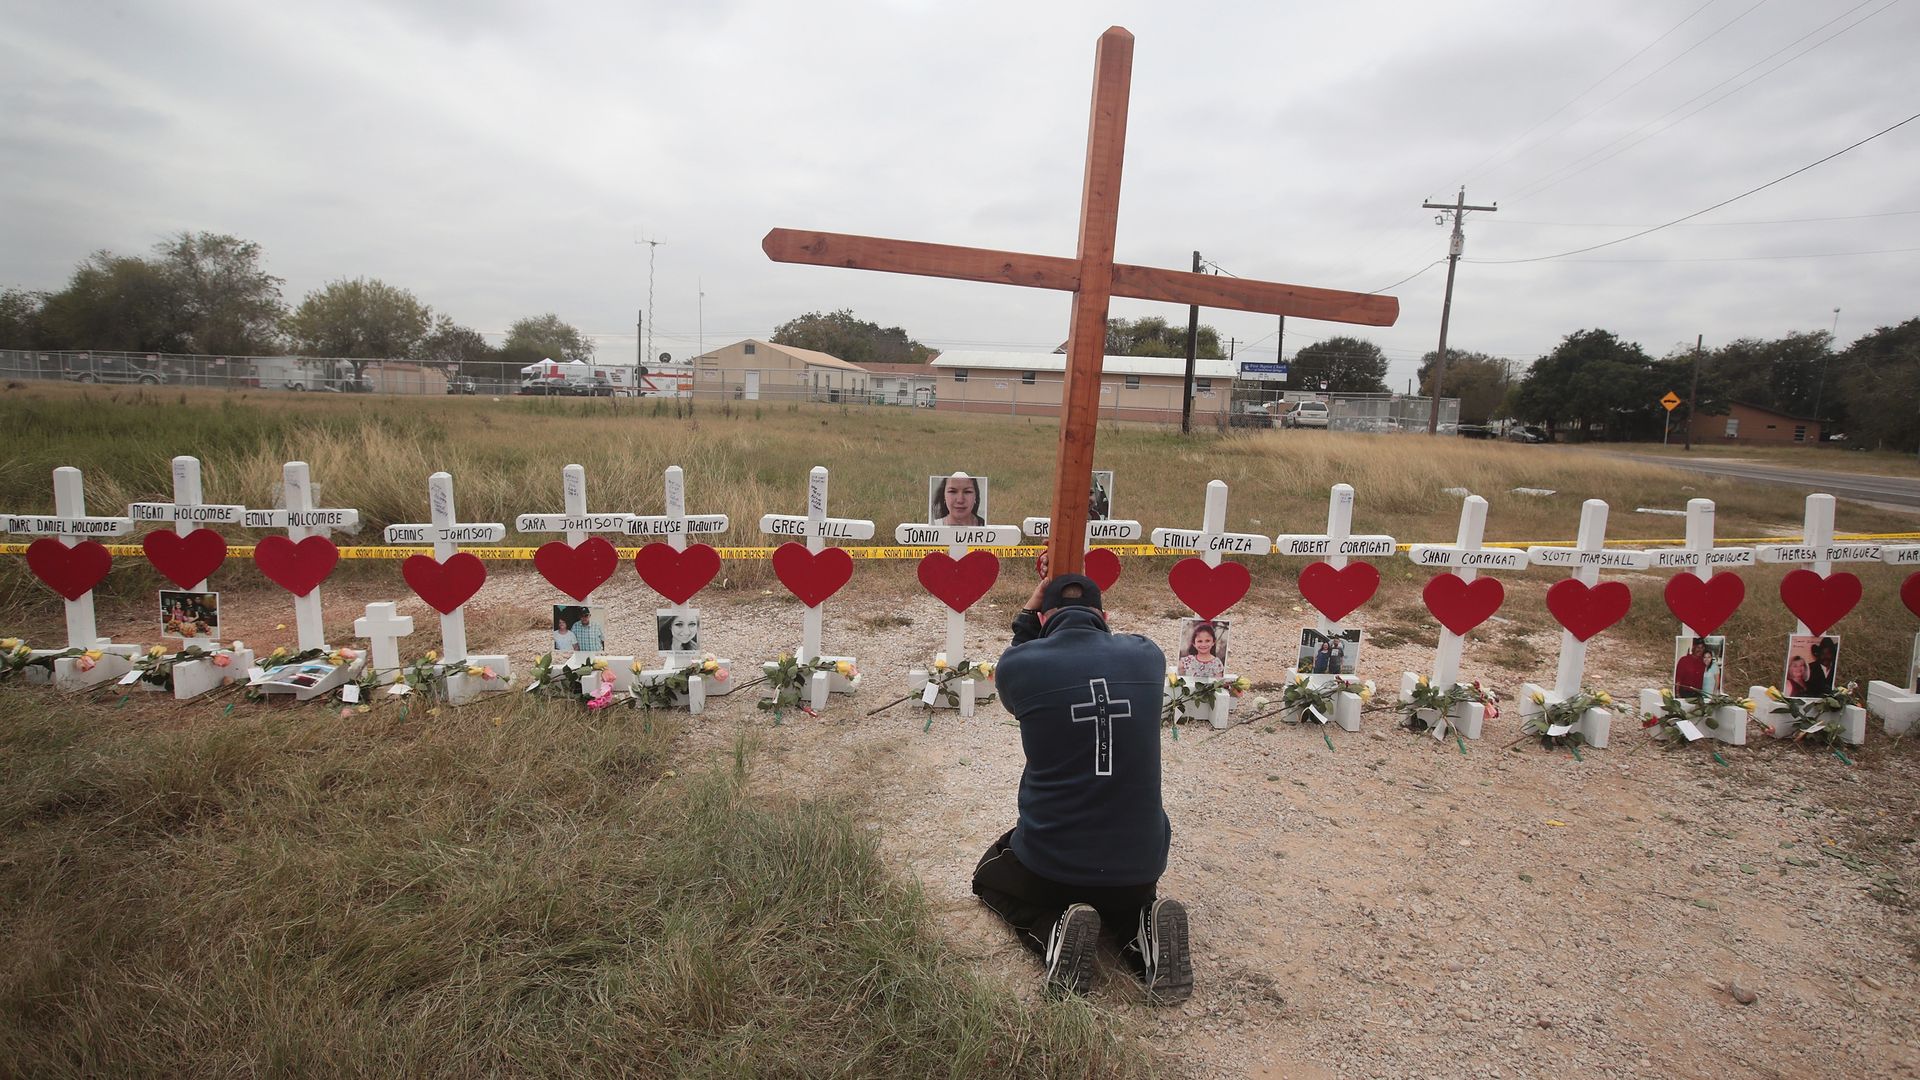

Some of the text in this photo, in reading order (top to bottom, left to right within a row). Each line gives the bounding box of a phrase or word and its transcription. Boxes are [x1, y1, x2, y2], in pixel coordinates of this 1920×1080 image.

[132, 505, 232, 520] MEGAN HOLCOMBE
[245, 512, 342, 526] EMILY HOLCOMBE
[9, 519, 117, 533] MARC DANIEL HOLCOMBE
[521, 517, 624, 531] SARA JOHNSON
[627, 520, 649, 534] TARA
[653, 520, 681, 533] ELYSE
[771, 519, 852, 537] GREG HILL
[438, 528, 492, 541] JOHNSON
[903, 528, 996, 544] JOANN WARD
[1091, 525, 1131, 538] WARD
[1164, 533, 1199, 548] EMILY
[1210, 534, 1252, 551] GARZA
[1291, 541, 1330, 553] ROBERT
[1340, 541, 1390, 554] CORRIGAN
[480, 550, 498, 558] SCENE
[498, 549, 514, 558] CRIME
[744, 549, 762, 558] SCENE
[884, 549, 902, 558] CROSS
[1013, 548, 1032, 557] SCENE
[1542, 551, 1634, 566] SCOTT MARSHALL
[1659, 552, 1750, 565] RICHARD RODRIGUEZ
[1774, 548, 1881, 561] THERESA RODRIGUEZ
[1898, 550, 1920, 562] KAR
[1461, 553, 1515, 566] CORRIGAN
[1098, 694, 1108, 762] CHRIST
